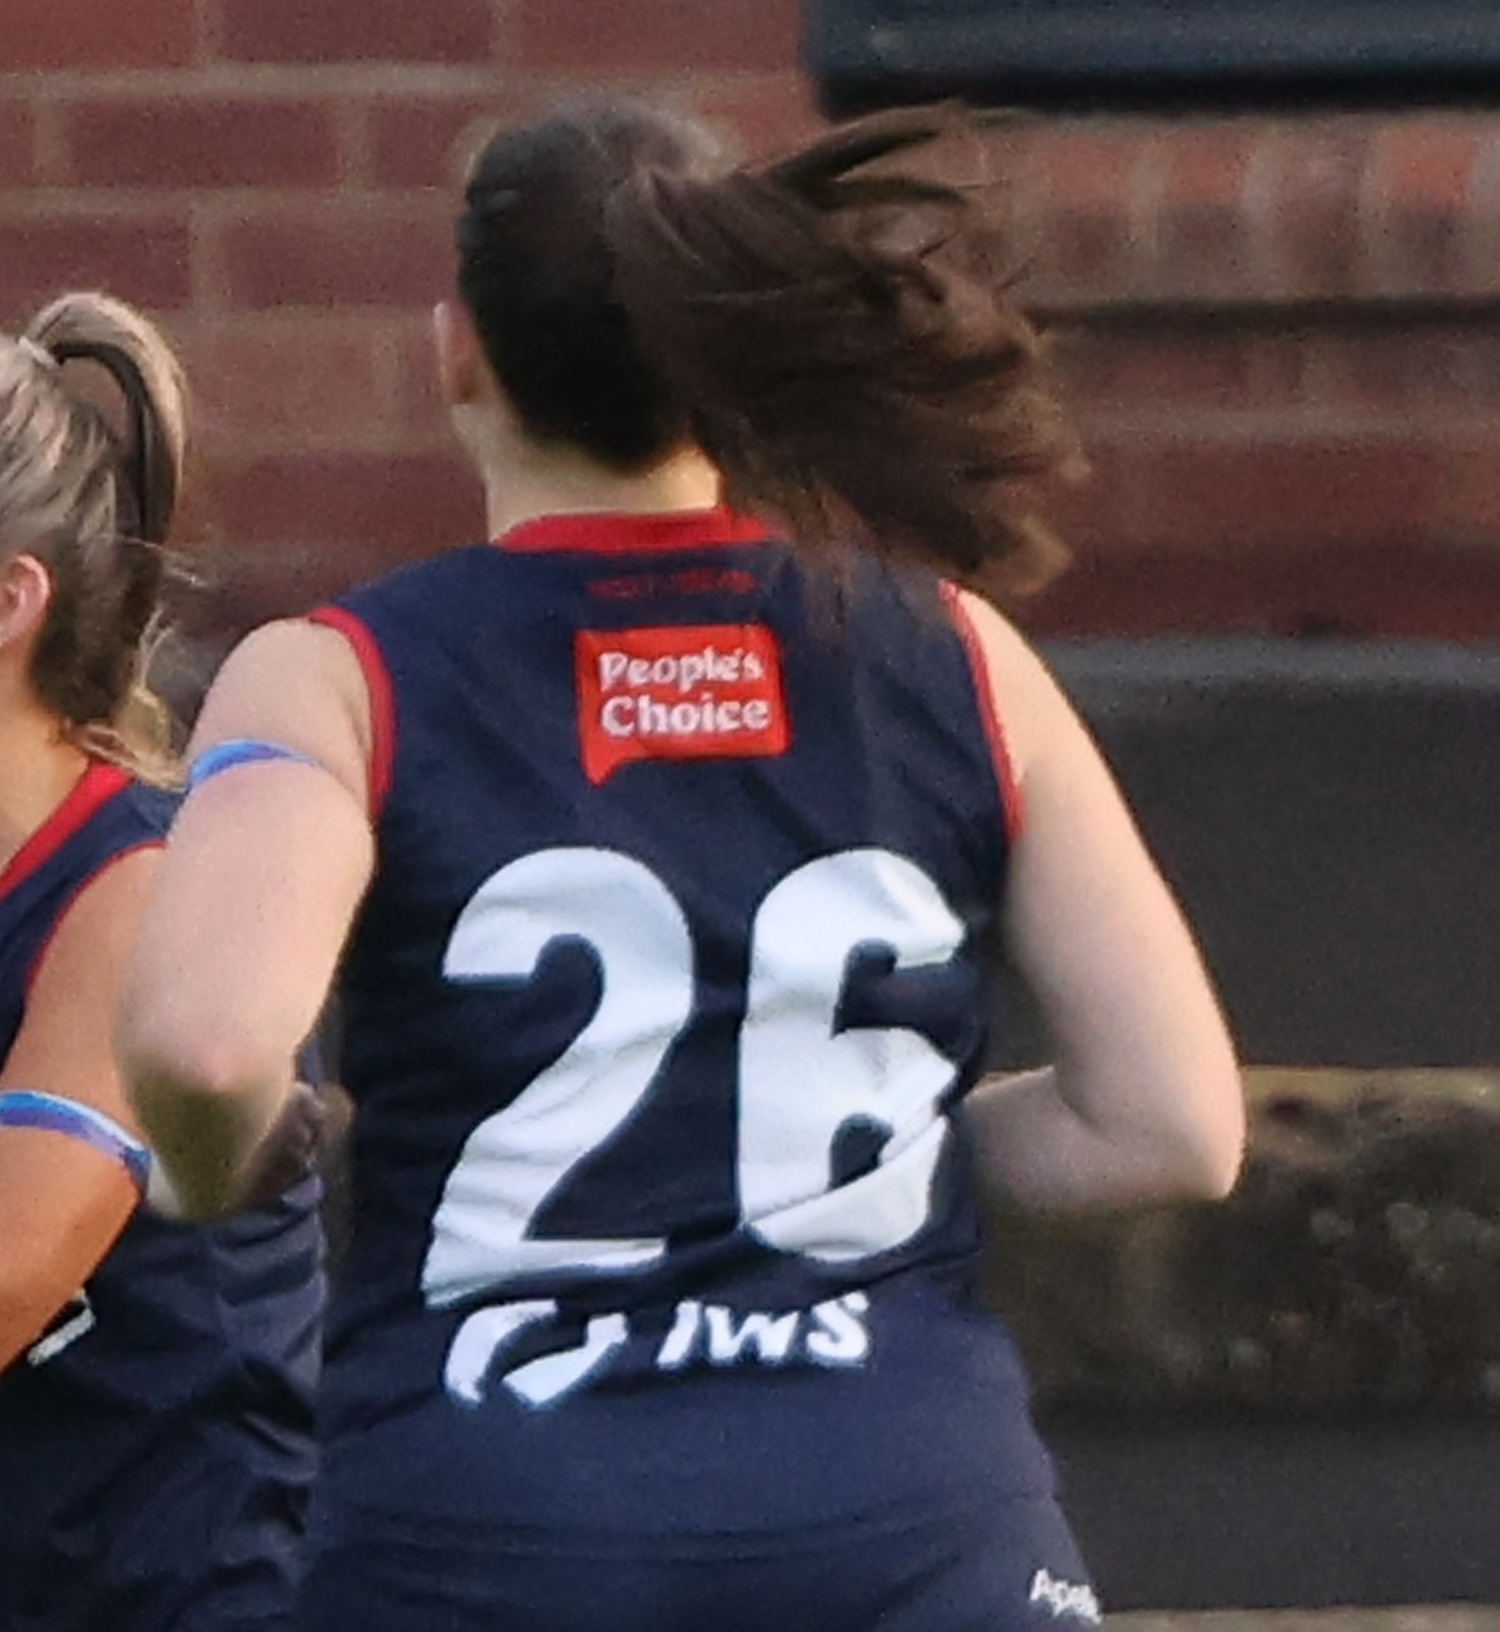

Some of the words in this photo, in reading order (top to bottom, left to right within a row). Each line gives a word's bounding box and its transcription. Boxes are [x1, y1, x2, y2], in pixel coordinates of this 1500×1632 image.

[599, 646, 763, 693] People's
[602, 691, 771, 736] Choice
[420, 846, 965, 1311] 26
